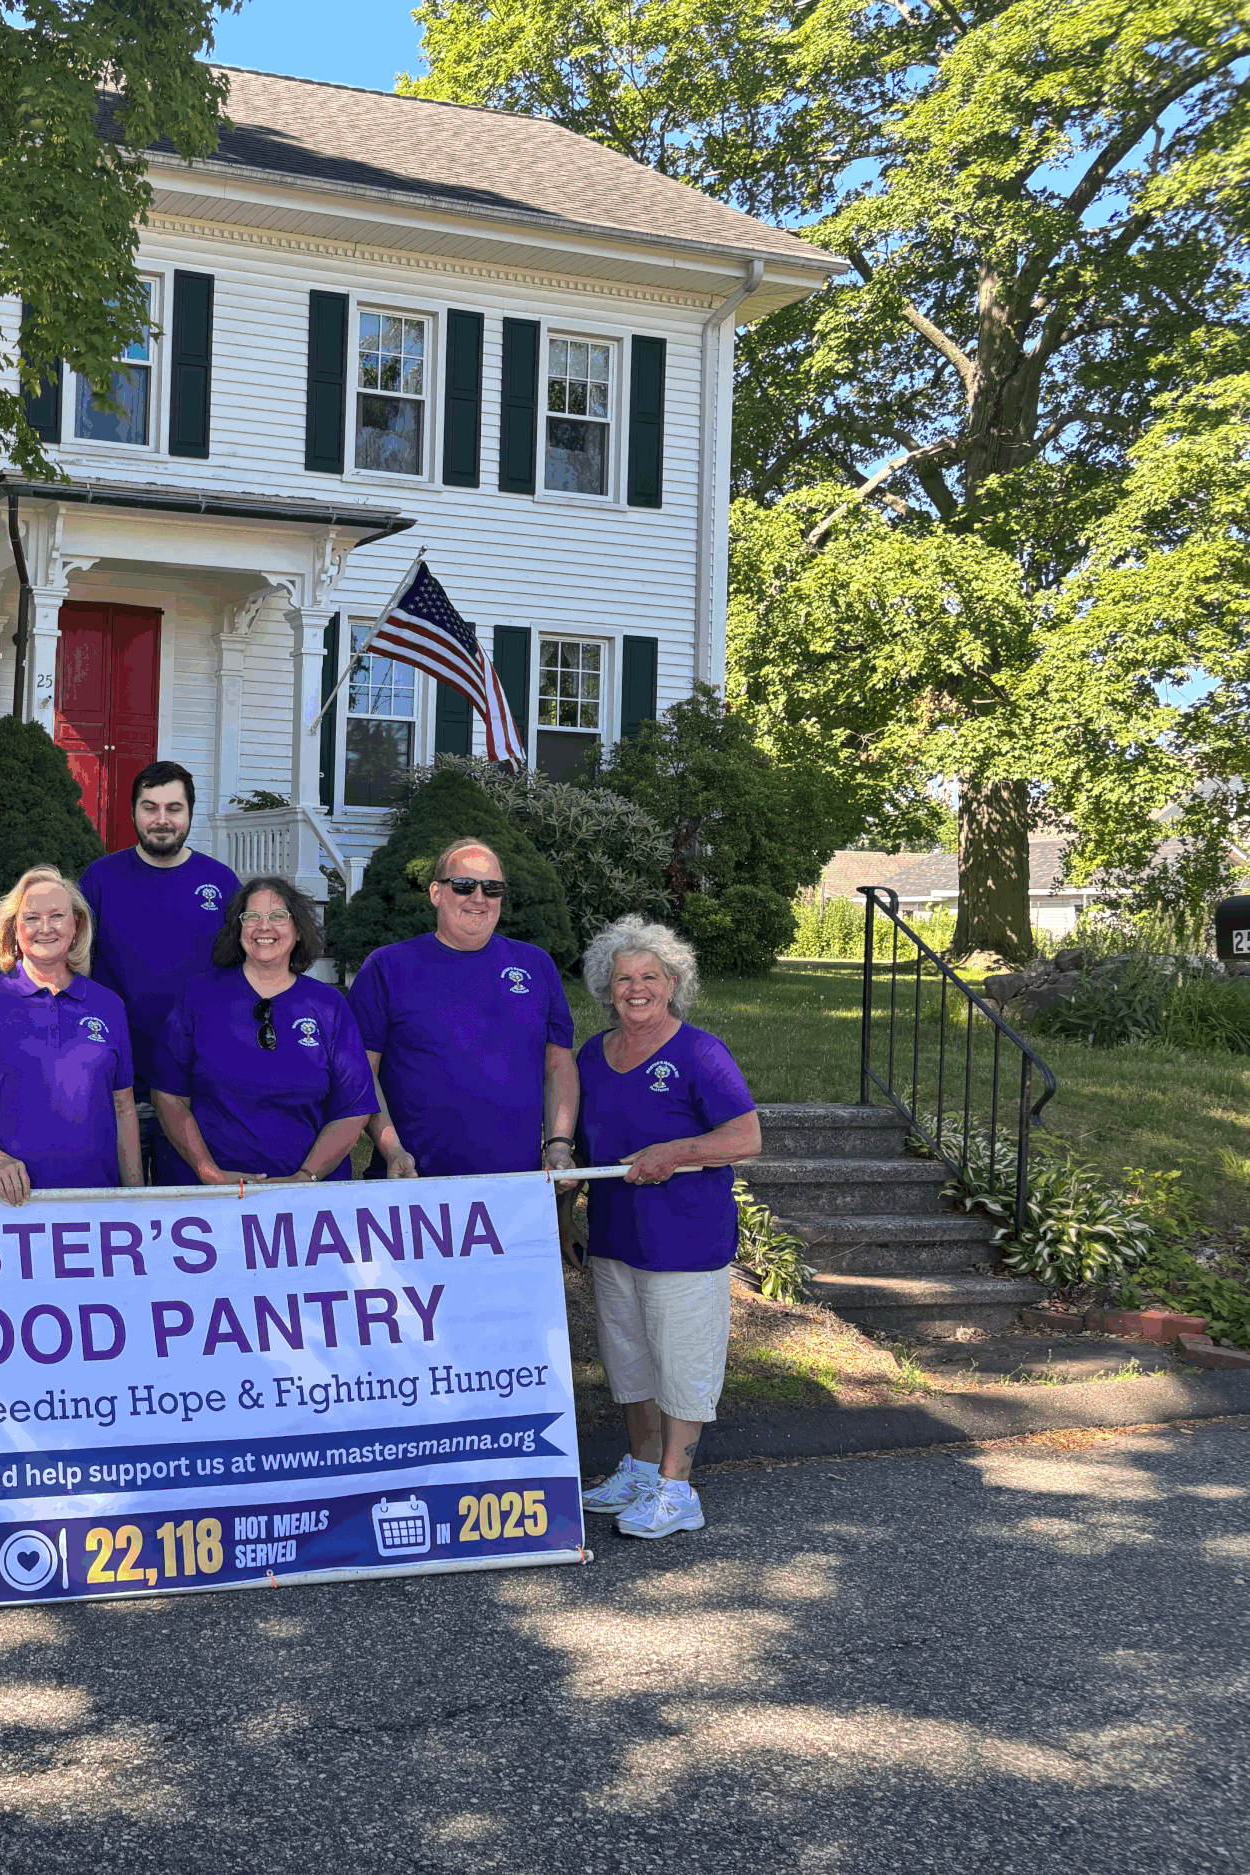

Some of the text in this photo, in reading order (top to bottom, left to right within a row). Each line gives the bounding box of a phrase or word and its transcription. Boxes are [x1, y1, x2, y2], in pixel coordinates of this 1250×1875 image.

[37, 674, 53, 688] 25
[241, 1201, 505, 1270] MANNA
[151, 1284, 446, 1358] PANTRY
[128, 1384, 227, 1422] Hope
[238, 1379, 265, 1410] &
[273, 1372, 420, 1413] Fighting
[429, 1363, 549, 1398] Hunger
[26, 1462, 82, 1489] help
[89, 1456, 191, 1486] support
[196, 1456, 225, 1475] us
[231, 1452, 256, 1473] at
[262, 1429, 536, 1471] www.mastersmanna.org
[234, 1509, 330, 1541] HOT MEALS
[436, 1490, 548, 1545] IN 2025
[85, 1517, 224, 1586] 22,118
[234, 1539, 297, 1569] SERVED
